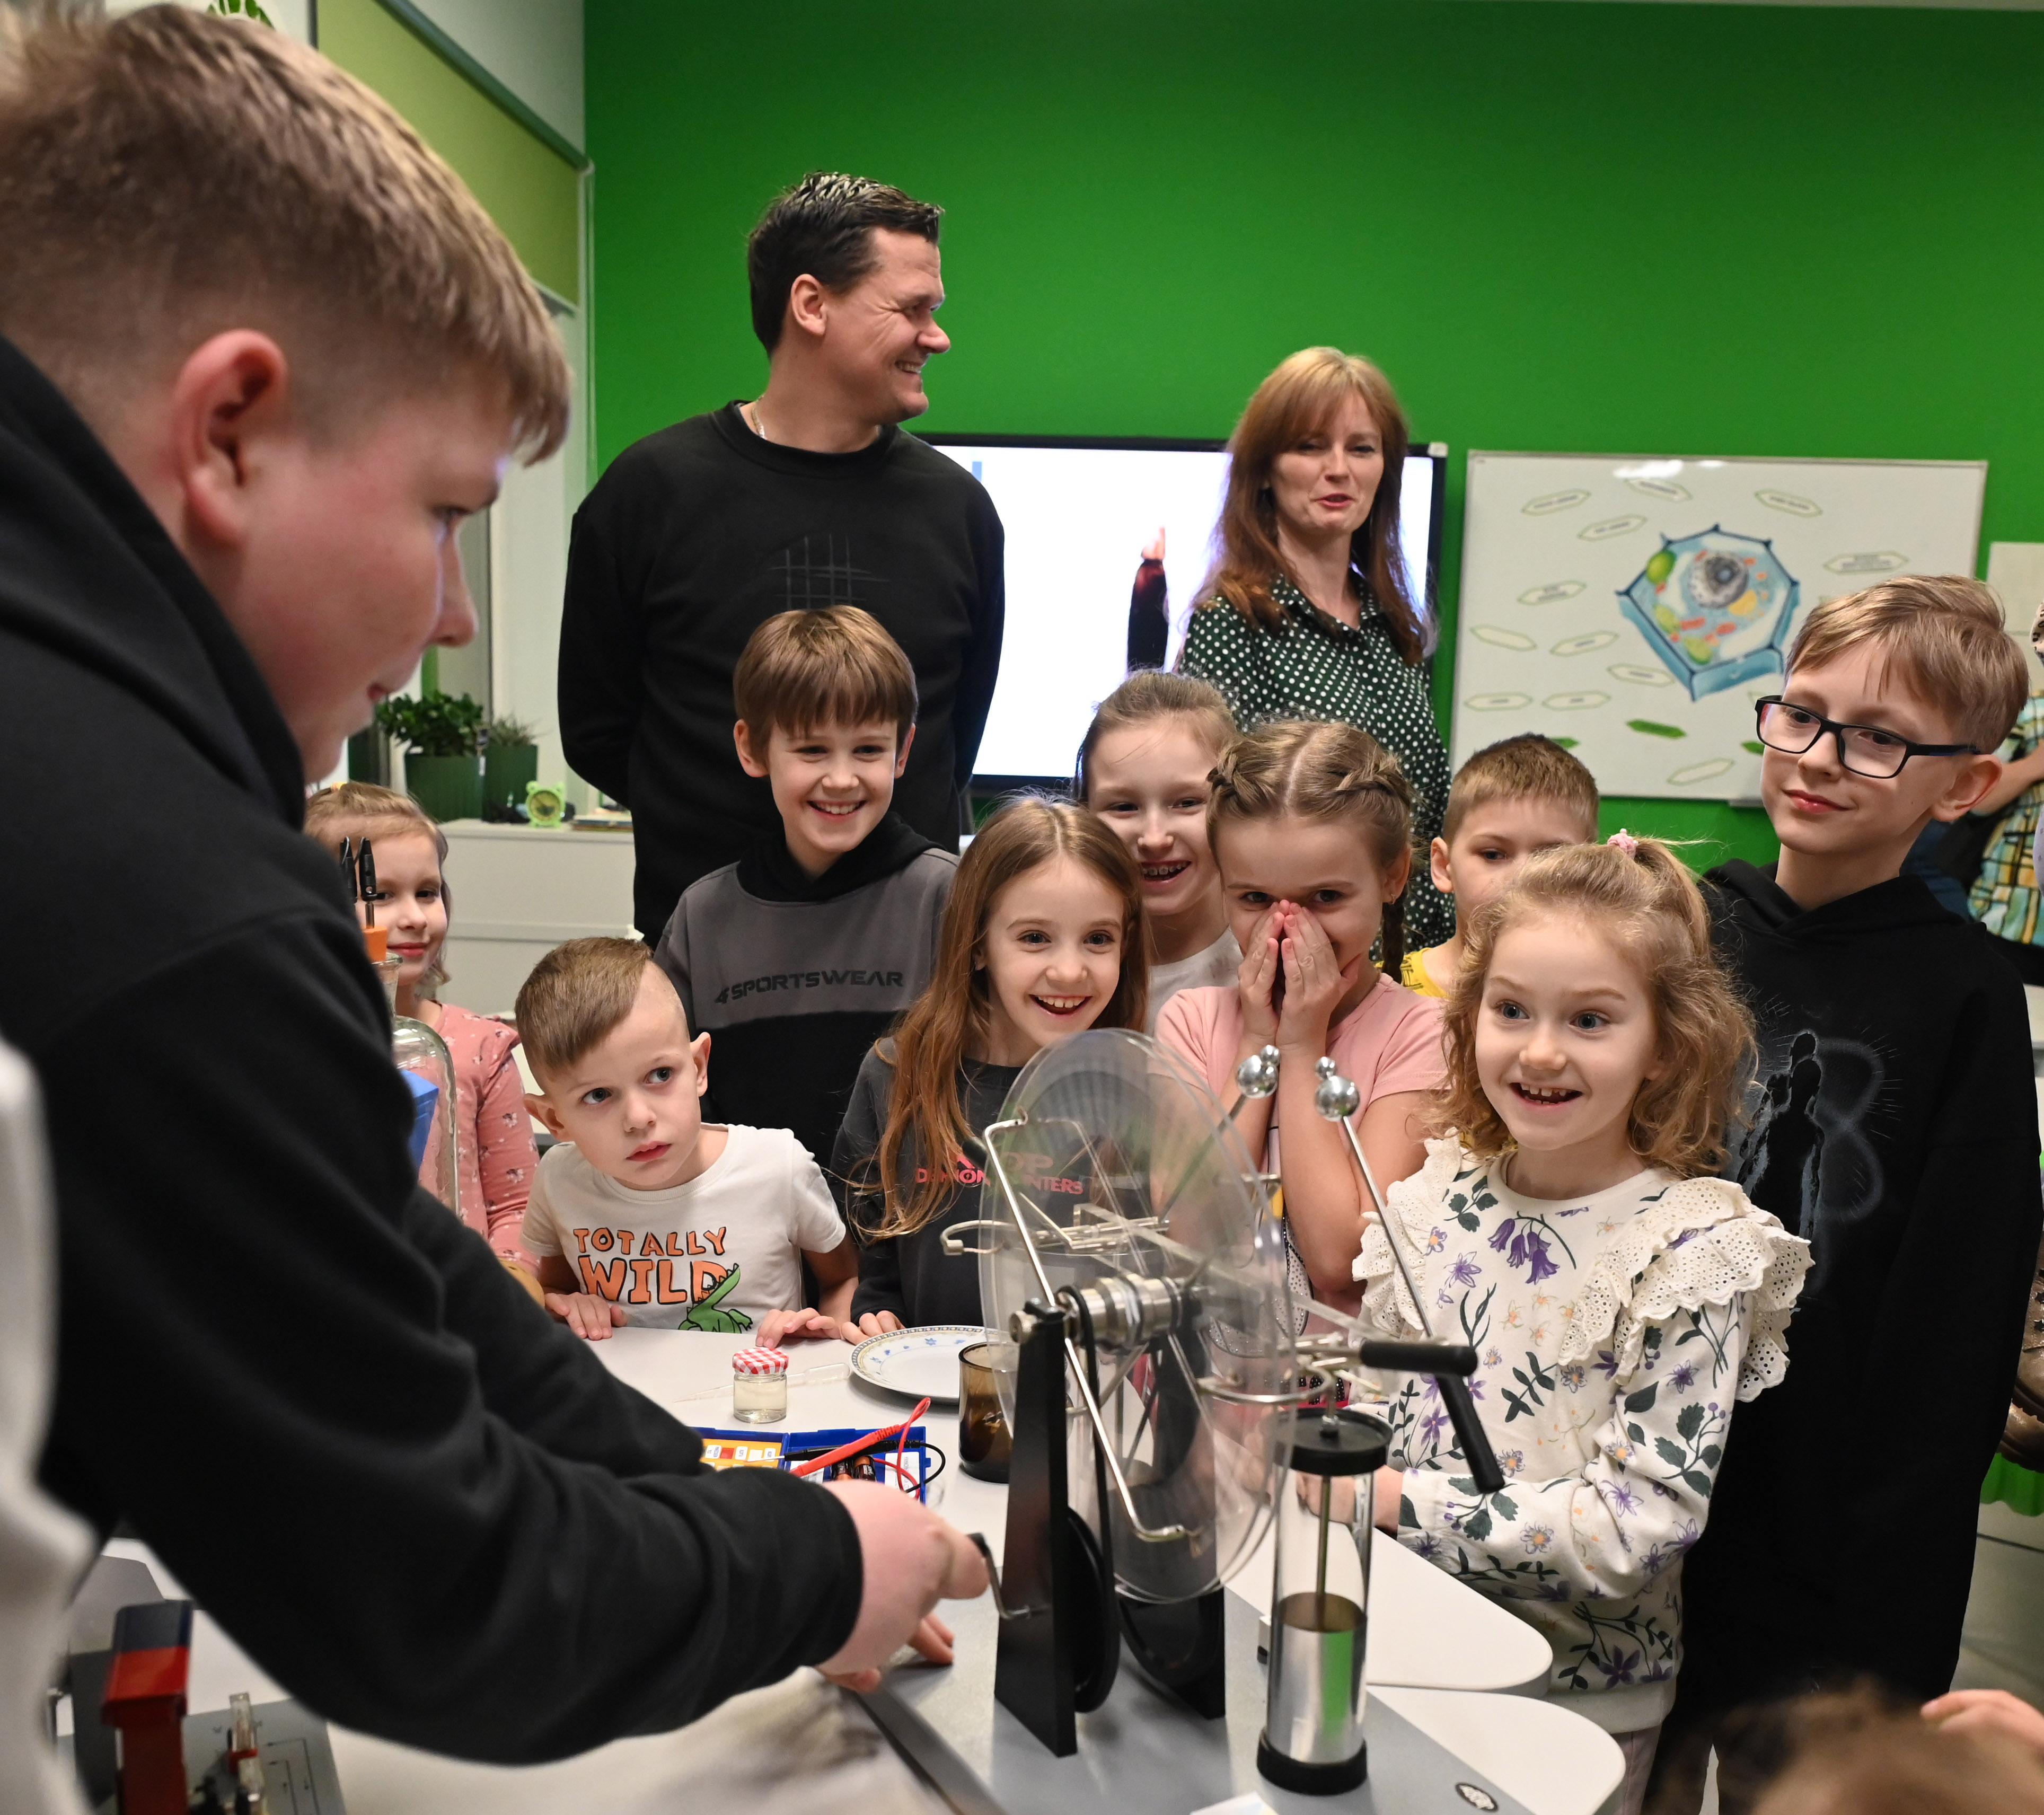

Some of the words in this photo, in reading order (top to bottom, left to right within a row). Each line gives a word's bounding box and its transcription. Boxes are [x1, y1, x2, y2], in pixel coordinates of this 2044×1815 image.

[731, 970, 904, 1000] SPORTSWEAR
[573, 1227, 726, 1256] TOTALLY
[578, 1255, 727, 1305] WILD
